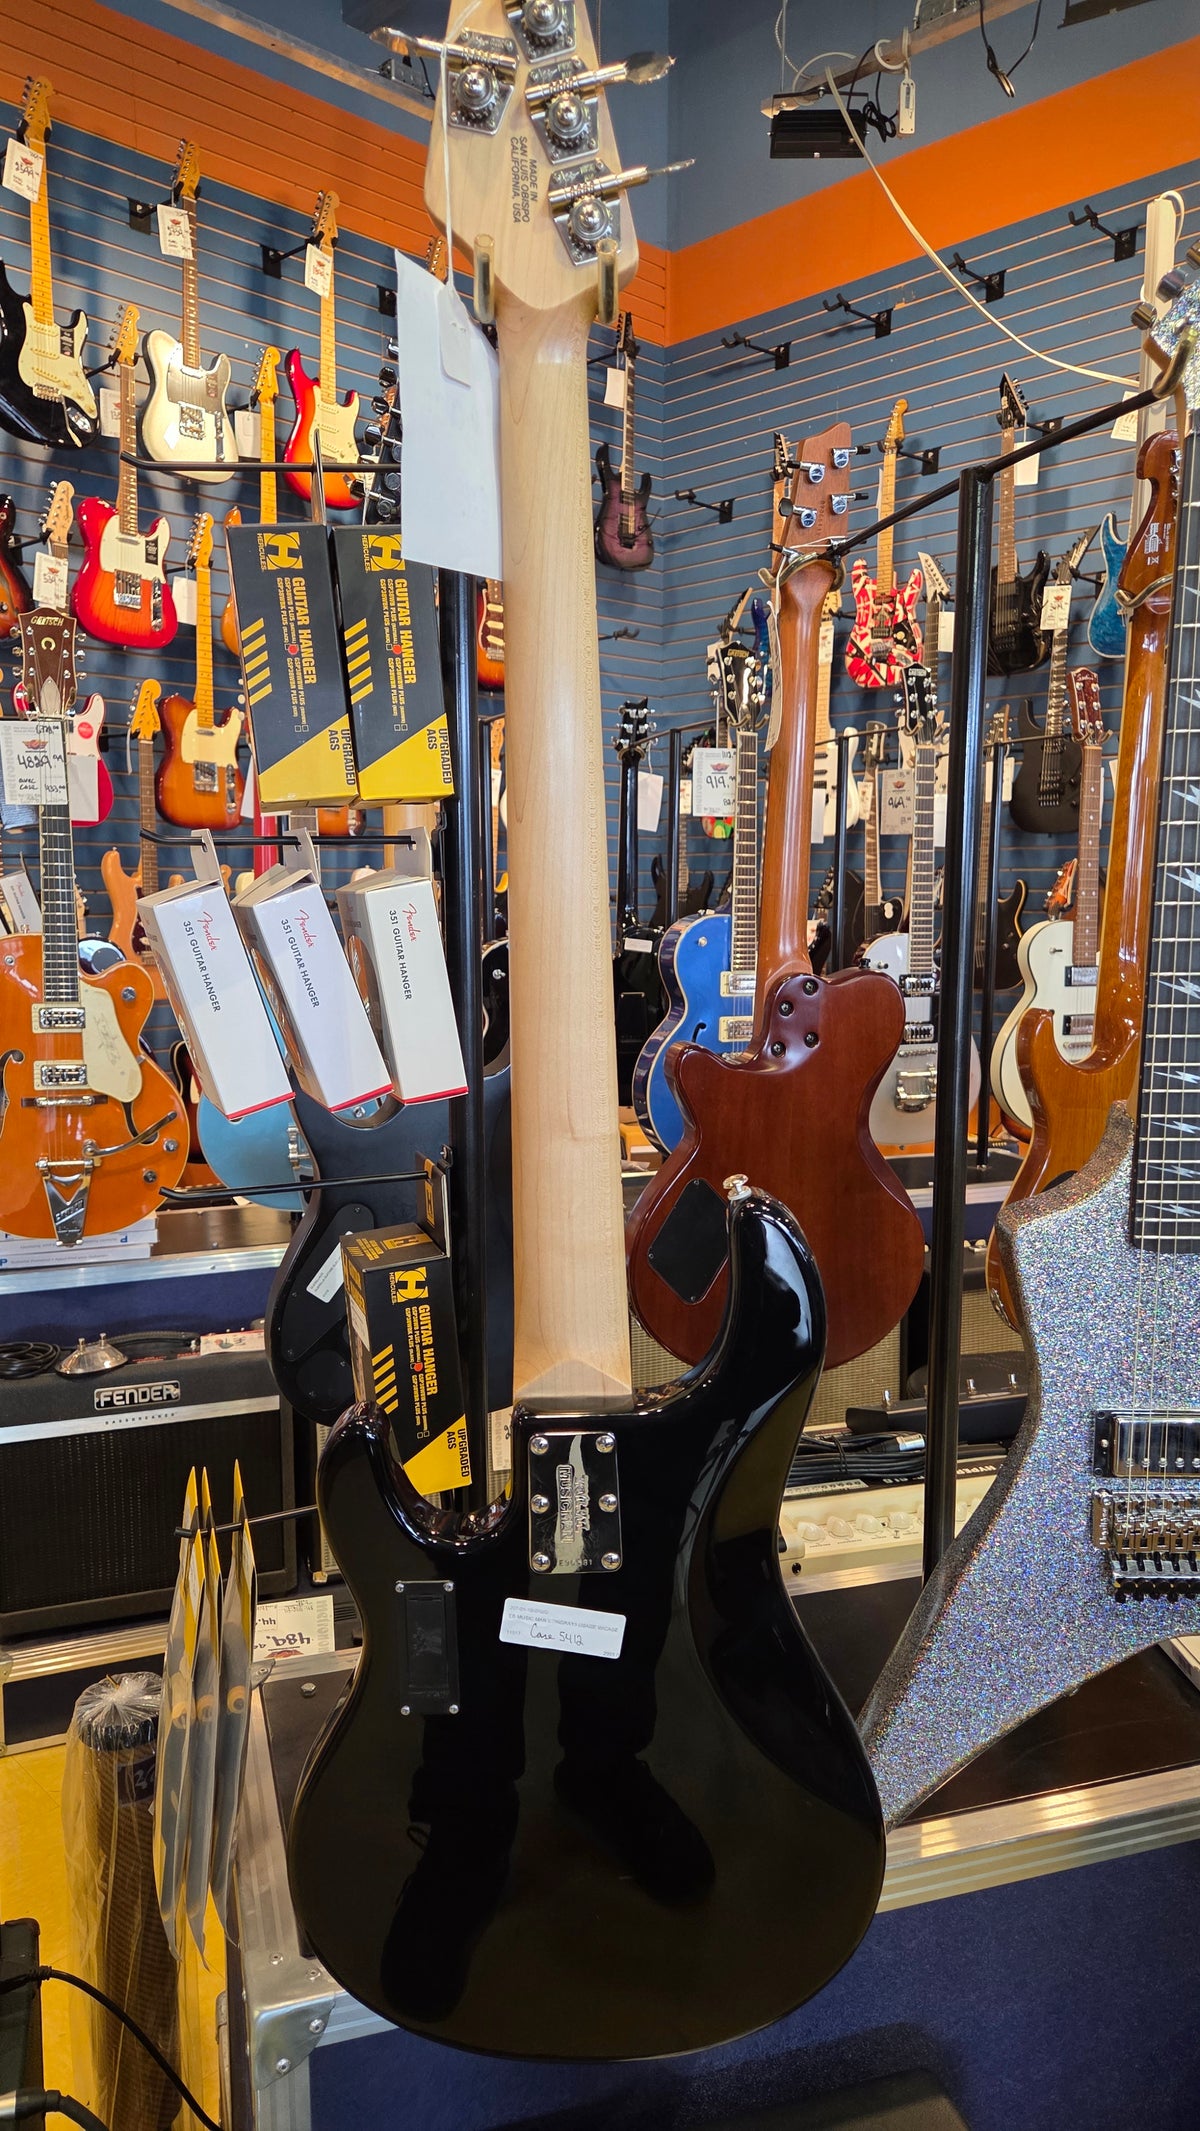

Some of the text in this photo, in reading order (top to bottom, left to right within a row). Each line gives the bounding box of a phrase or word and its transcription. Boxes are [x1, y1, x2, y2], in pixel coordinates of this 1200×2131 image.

[510, 136, 521, 223] CALIFORNIA, USA
[519, 135, 530, 223] SAN LUIS OBISPO
[529, 158, 538, 202] MADE IN
[257, 533, 267, 571] HERCULES
[361, 534, 371, 572] HERCULES
[292, 577, 317, 684] GUITAR HANGER
[394, 578, 417, 684] GUITAR HANGER
[328, 729, 340, 751] AGS
[340, 728, 356, 786] UPGRADED
[426, 729, 437, 750] AGS
[438, 728, 452, 784] UPGRADED
[197, 911, 220, 951] Fender
[294, 909, 317, 948] Fender
[402, 903, 422, 942] Fender
[183, 920, 221, 1012] 351 GUITAR HANGER
[281, 918, 320, 1008] 351 GUITAR HANGER
[389, 909, 412, 1001] 351 GUITAR HANGER
[389, 1272, 397, 1304] HERCULES
[418, 1304, 438, 1396] GUITAR HANGER
[100, 1384, 178, 1407] FENDER
[446, 1431, 457, 1450] AGS
[457, 1428, 470, 1478] UPGRADED
[530, 1622, 584, 1646] Case 5412
